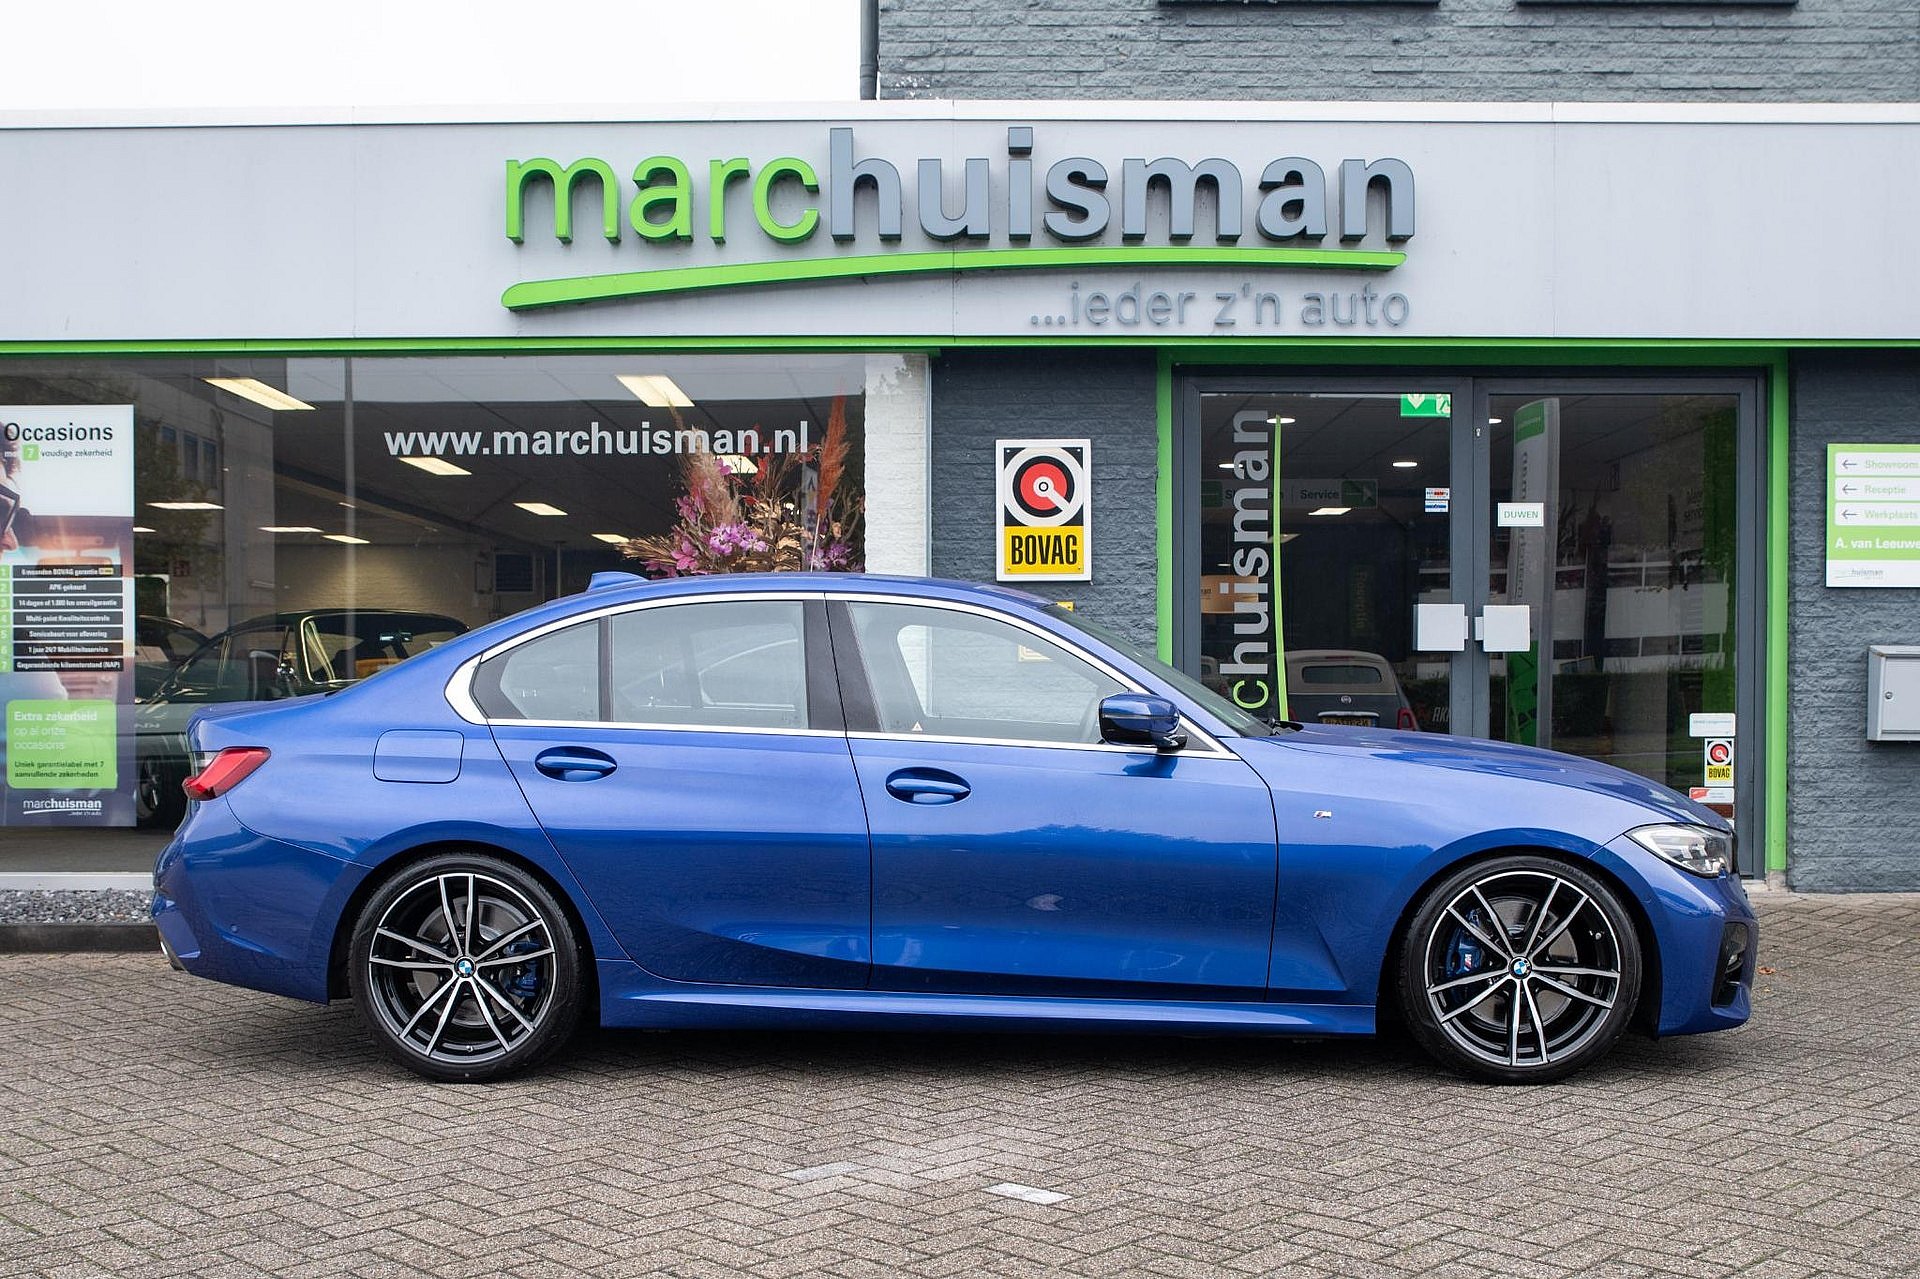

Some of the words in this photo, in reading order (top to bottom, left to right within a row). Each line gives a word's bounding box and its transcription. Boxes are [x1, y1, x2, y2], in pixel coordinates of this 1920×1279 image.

[505, 127, 1415, 244] marchuisman
[1029, 281, 1196, 326] ...ieder
[1214, 281, 1281, 326] z'n
[1301, 281, 1411, 327] auto
[4, 422, 113, 441] Occasions
[384, 421, 808, 456] www.marchuisman.nl
[41, 448, 73, 458] voudige
[75, 448, 113, 457] zekerheid
[1300, 489, 1340, 500] Service
[1864, 484, 1906, 496] Receptie
[1503, 509, 1540, 519] DUWEN
[1864, 509, 1919, 520] Werkplaats
[1834, 537, 1848, 549] A.
[1850, 539, 1873, 549] van
[1010, 534, 1078, 566] BOVAG
[1219, 410, 1269, 709] chuisman
[14, 711, 43, 721] Extra
[46, 711, 98, 721] zekerheid
[14, 760, 35, 768] Uniek
[83, 760, 98, 768] met
[1708, 767, 1731, 779] BOVAG
[23, 798, 102, 809] marchuisman
